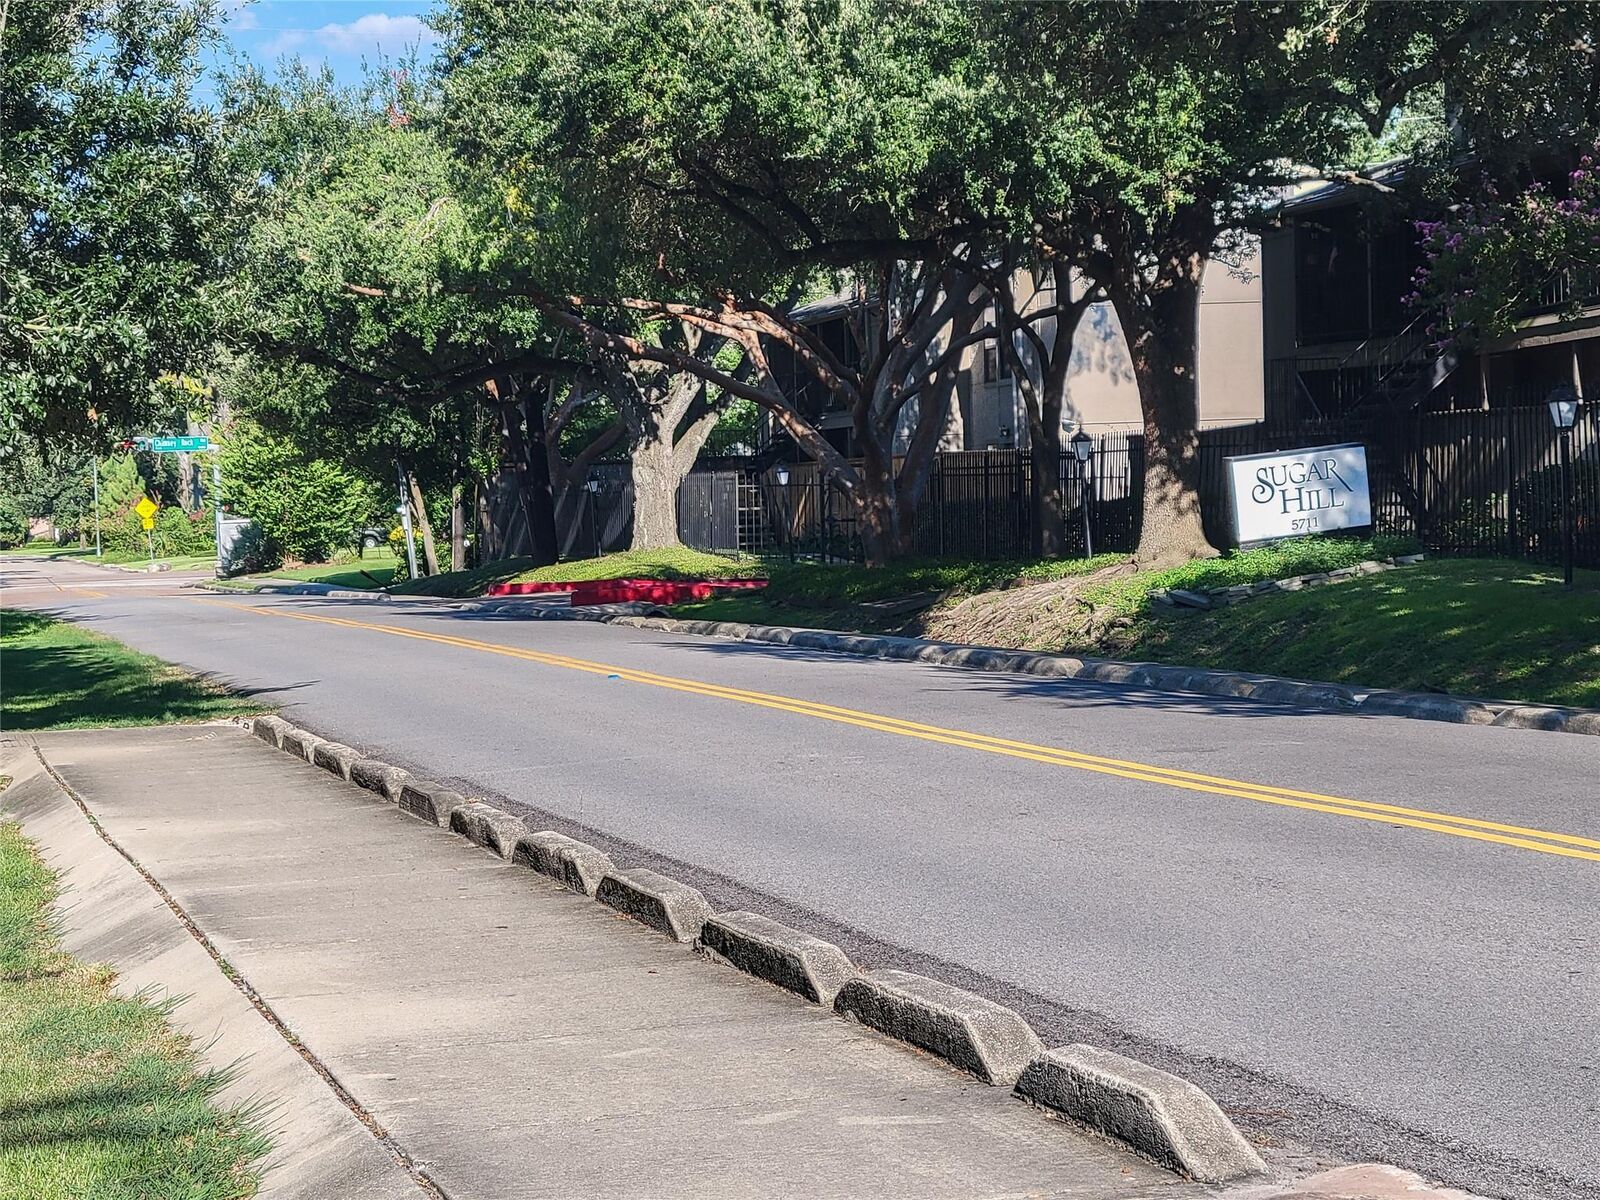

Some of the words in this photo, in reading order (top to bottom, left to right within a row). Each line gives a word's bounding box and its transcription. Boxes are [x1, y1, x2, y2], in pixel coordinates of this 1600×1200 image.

[1251, 458, 1354, 504] SUGAR
[1279, 486, 1345, 514] HILL
[1291, 517, 1319, 531] 5711
